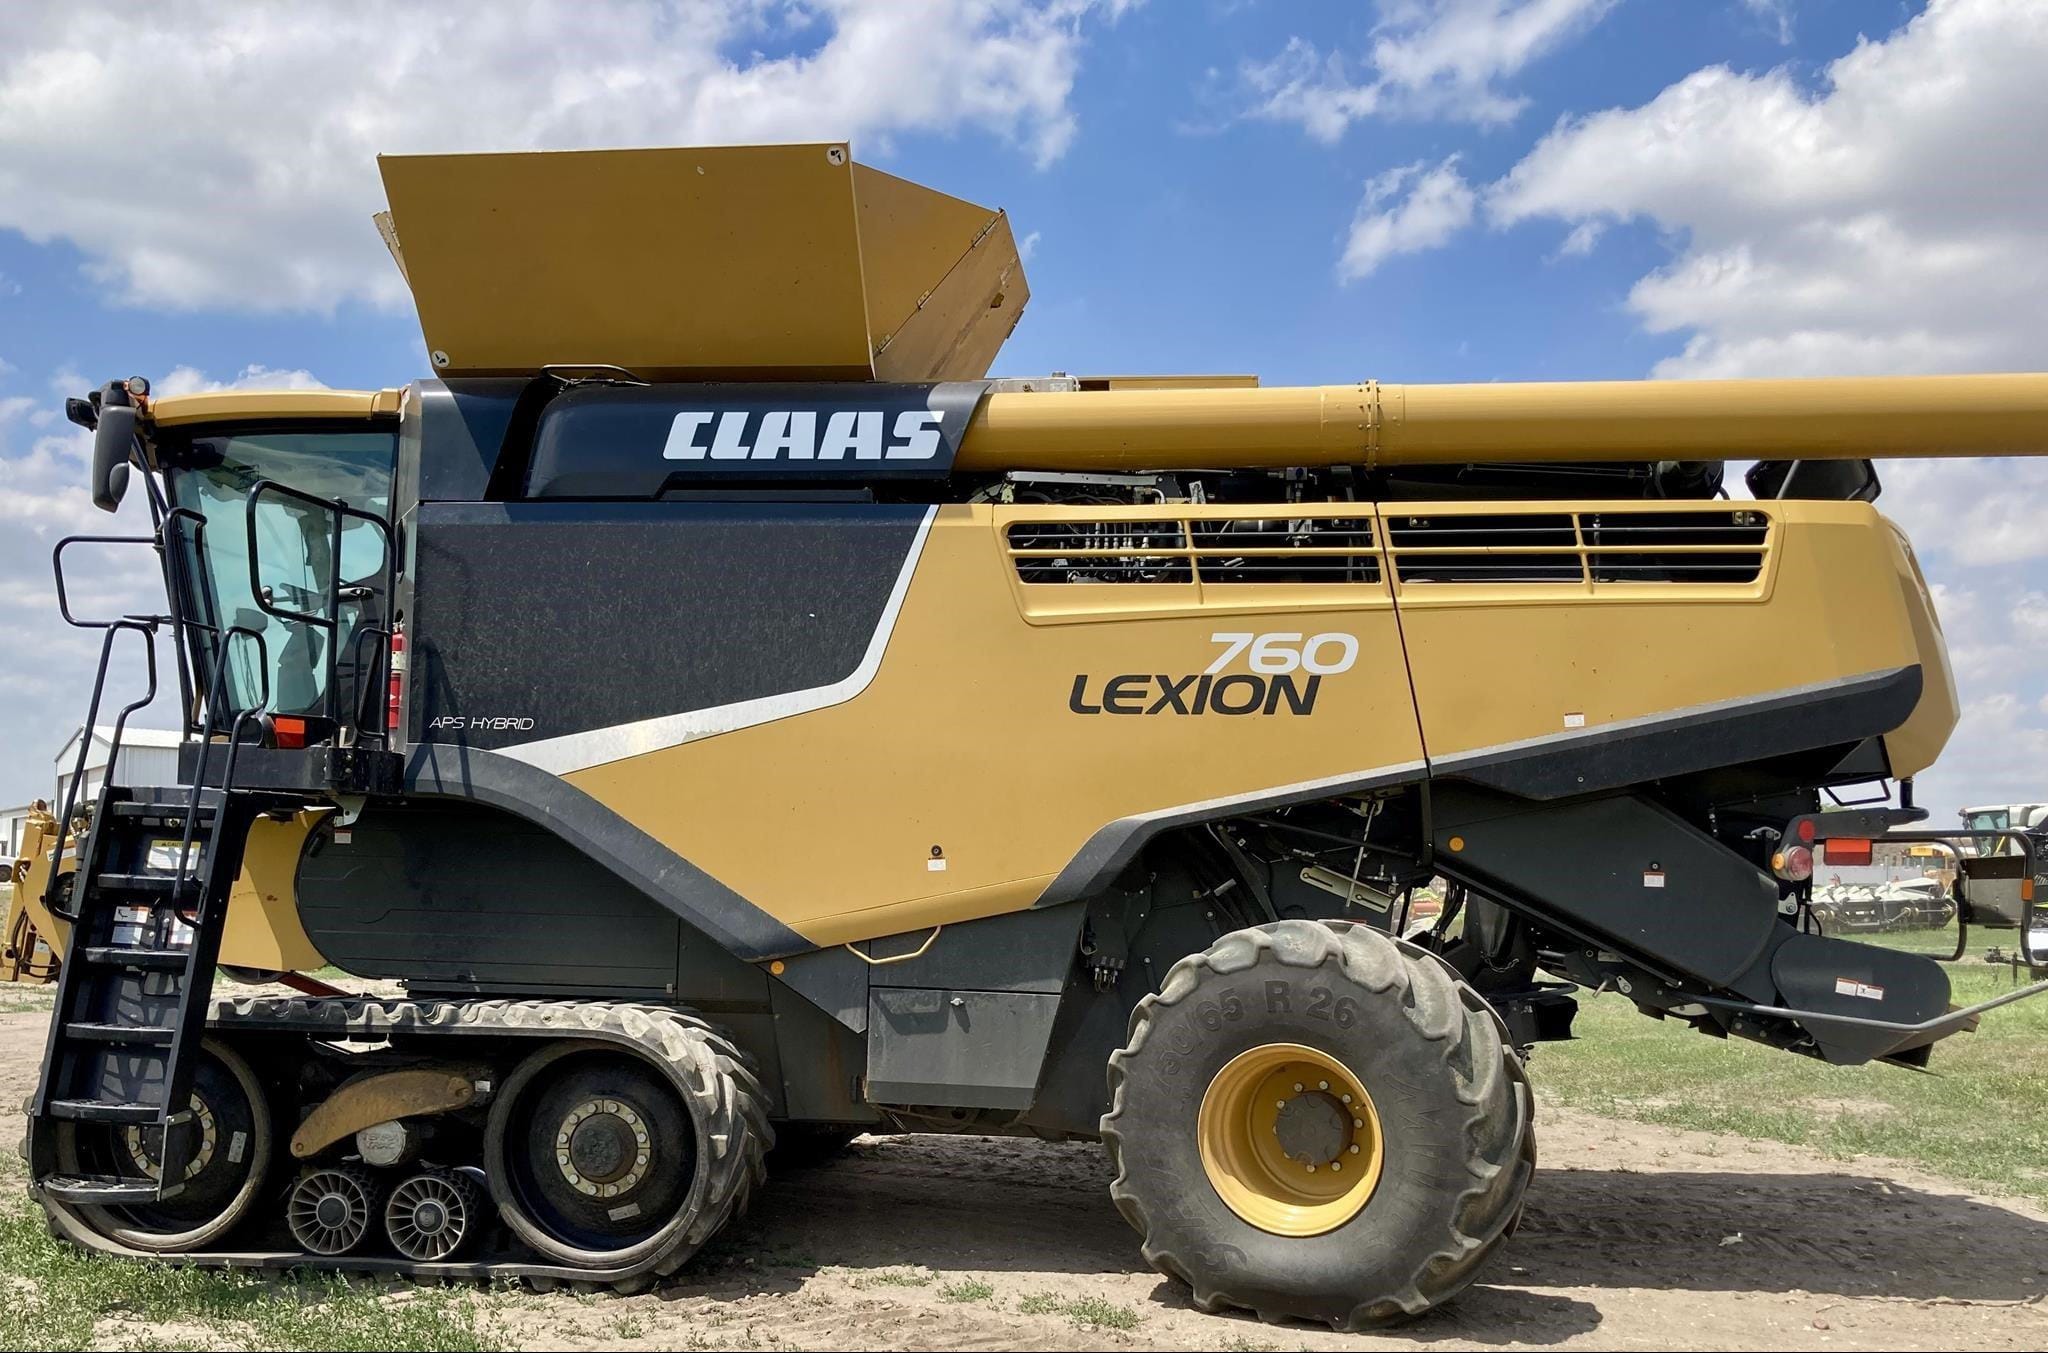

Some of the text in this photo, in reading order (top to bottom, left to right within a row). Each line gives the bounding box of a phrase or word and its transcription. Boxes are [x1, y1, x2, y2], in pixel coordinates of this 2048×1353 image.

[663, 411, 945, 460] CLAAS
[1204, 632, 1360, 674] 760
[1069, 674, 1322, 716] LEXION
[428, 716, 535, 730] APS HYBRID
[1264, 980, 1293, 1014] R
[1306, 985, 1360, 1030] 26
